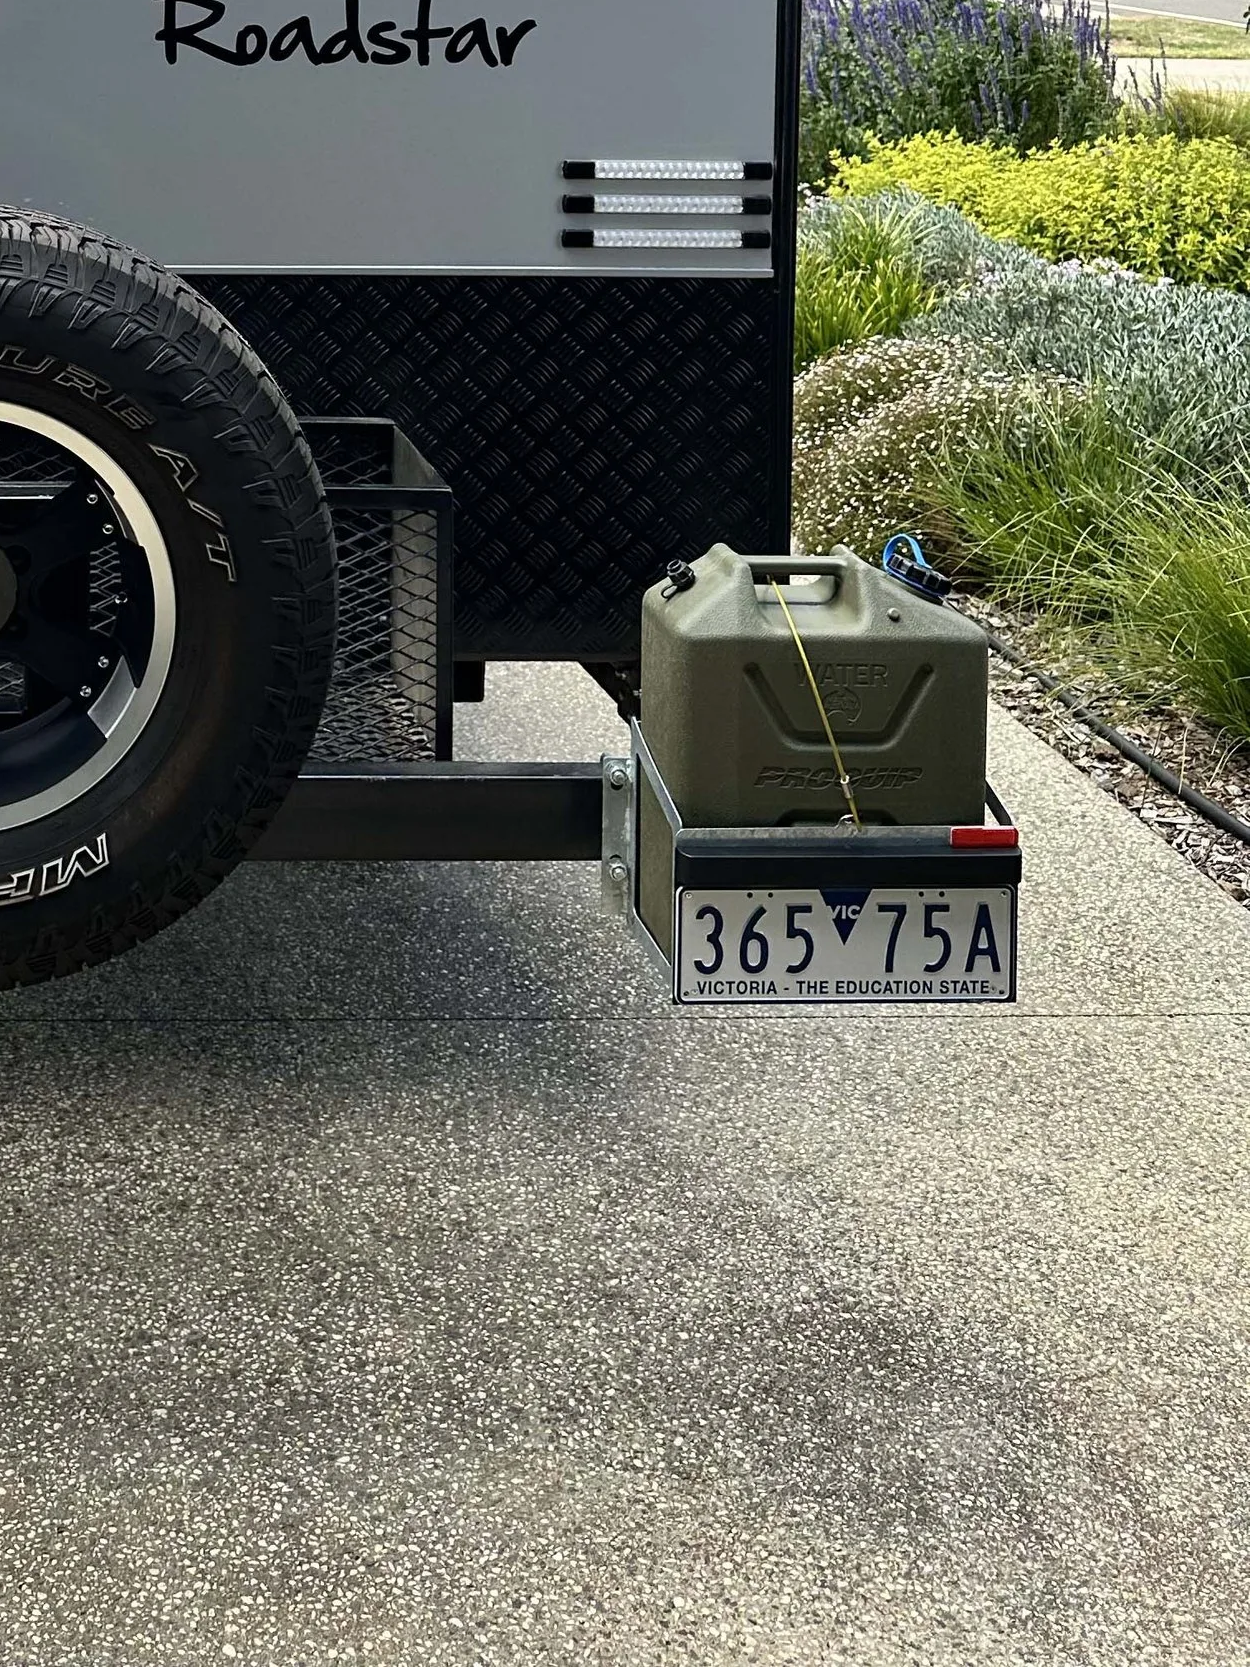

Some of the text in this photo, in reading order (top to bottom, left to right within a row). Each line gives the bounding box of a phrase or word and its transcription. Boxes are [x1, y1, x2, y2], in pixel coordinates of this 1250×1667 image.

[148, 442, 238, 584] A/T
[793, 662, 889, 687] WATER
[826, 905, 862, 921] VIC
[693, 902, 1002, 975] 365 75A
[697, 980, 778, 996] VICTORIA
[796, 980, 829, 995] THE
[835, 980, 936, 995] EDUCATION
[939, 980, 991, 995] STATE
